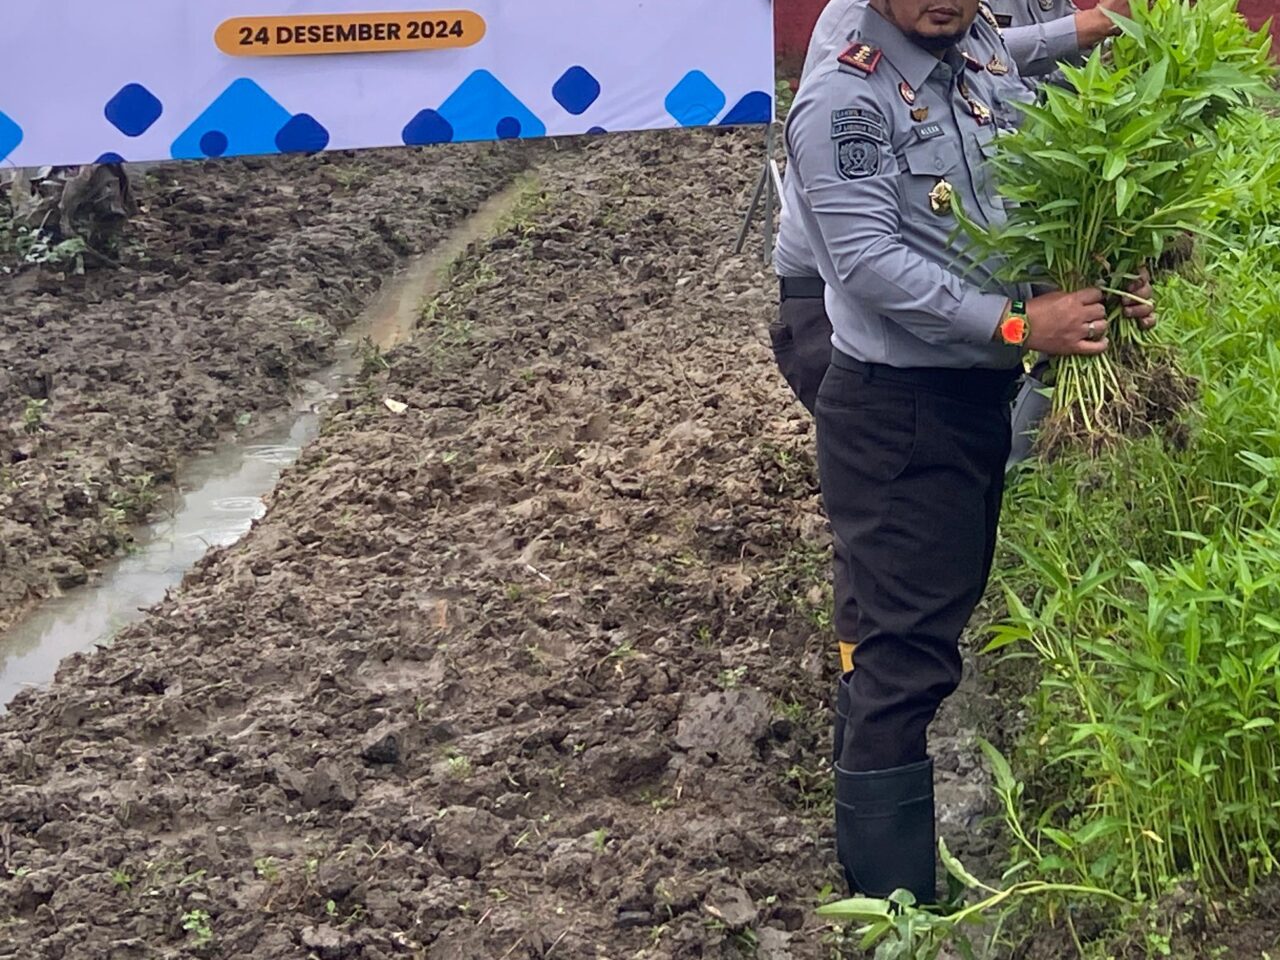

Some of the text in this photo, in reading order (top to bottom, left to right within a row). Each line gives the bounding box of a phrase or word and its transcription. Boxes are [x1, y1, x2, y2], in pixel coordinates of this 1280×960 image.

[239, 20, 464, 46] 24 DESEMBER 2024
